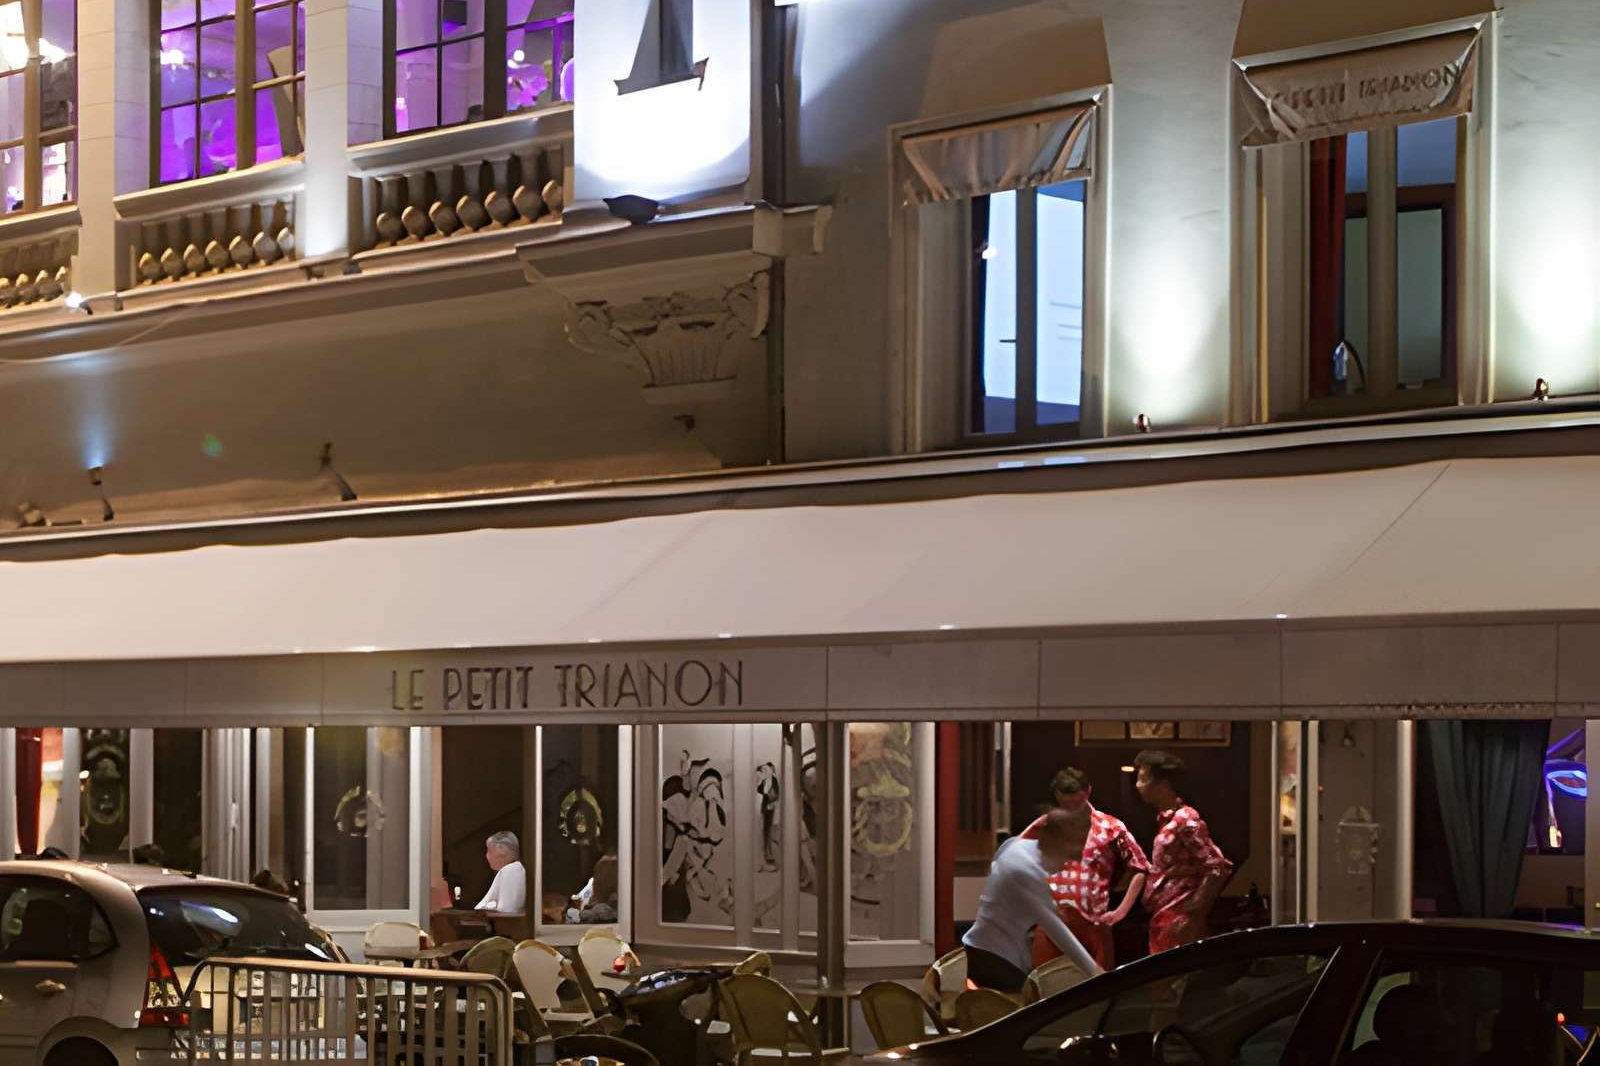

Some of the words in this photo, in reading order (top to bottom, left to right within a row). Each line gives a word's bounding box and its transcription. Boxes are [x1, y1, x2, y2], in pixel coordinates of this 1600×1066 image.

[390, 668, 426, 711] LE
[443, 665, 534, 711] PETIT
[553, 659, 743, 708] TRIANON
